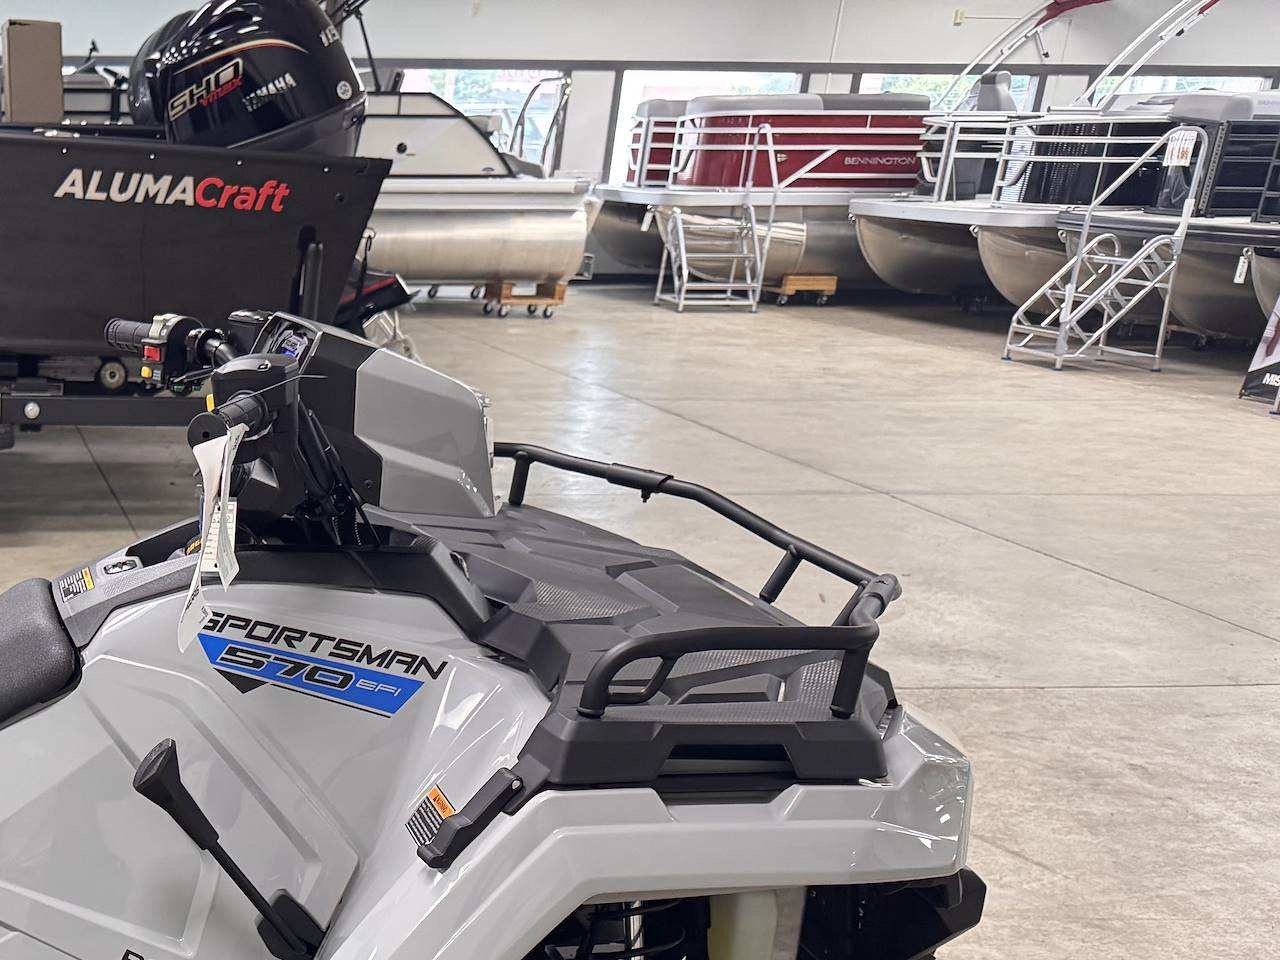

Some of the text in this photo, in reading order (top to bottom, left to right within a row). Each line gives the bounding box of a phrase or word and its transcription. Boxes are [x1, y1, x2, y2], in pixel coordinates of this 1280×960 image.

[169, 57, 244, 121] SHO
[844, 156, 916, 165] BENNINGTON
[53, 168, 291, 213] ALUMACraft
[201, 611, 448, 680] SPORTSMAN
[216, 645, 402, 697] 570 EFI
